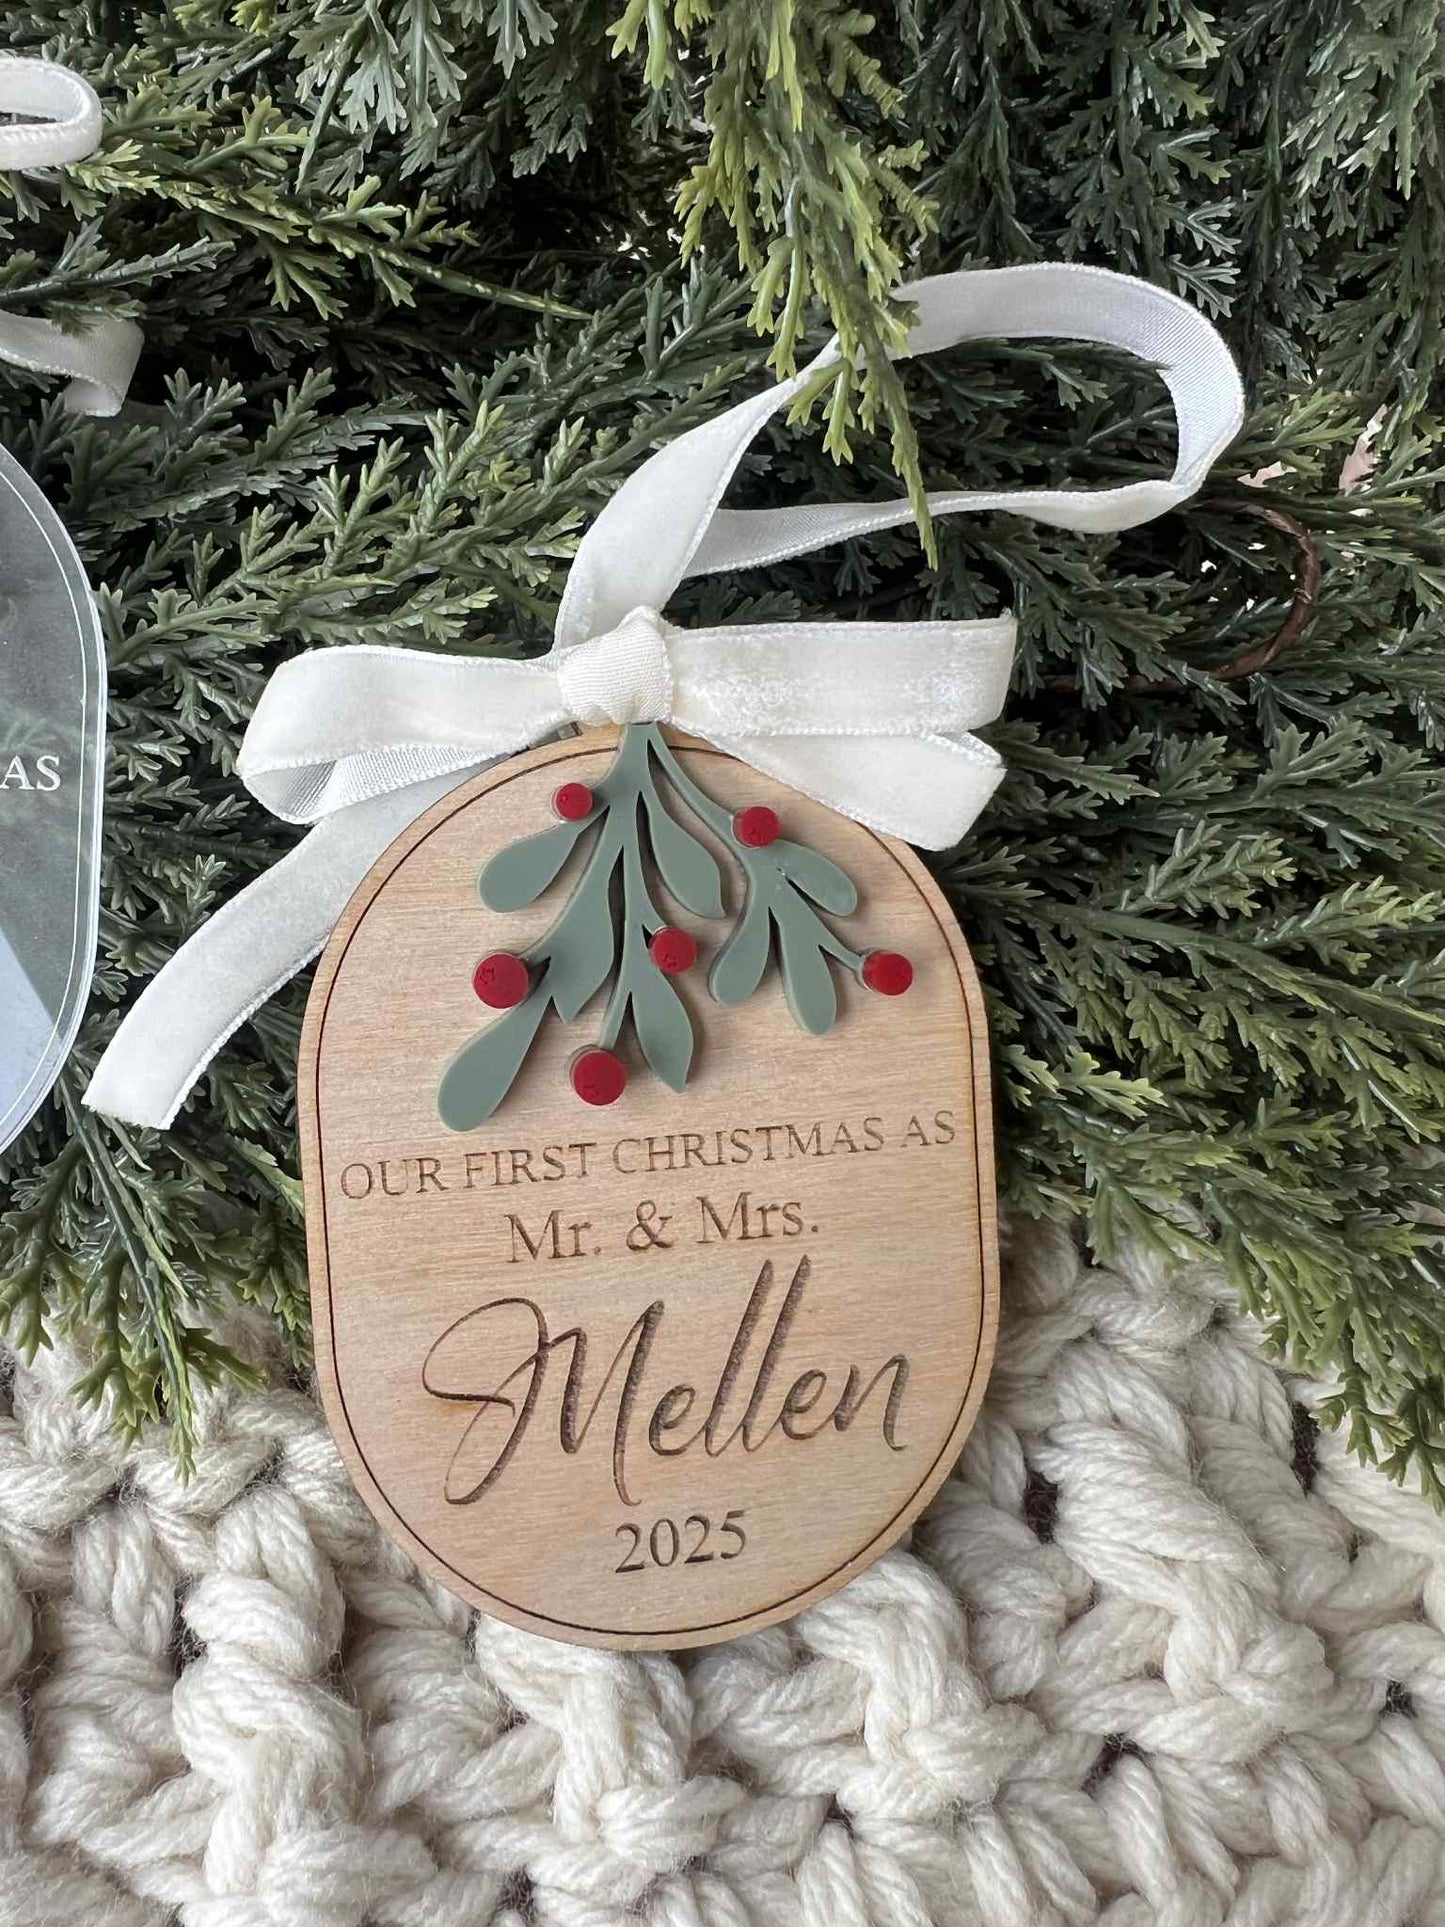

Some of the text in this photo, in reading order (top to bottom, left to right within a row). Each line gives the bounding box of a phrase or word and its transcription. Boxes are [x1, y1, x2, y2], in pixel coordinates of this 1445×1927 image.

[0, 755, 61, 791] AS
[341, 1109, 956, 1199] OUR FIRST CHRISTMAS AS
[504, 1191, 819, 1263] Mr. & Mrs.
[422, 1254, 910, 1506] Mellen
[615, 1510, 747, 1573] 2025
